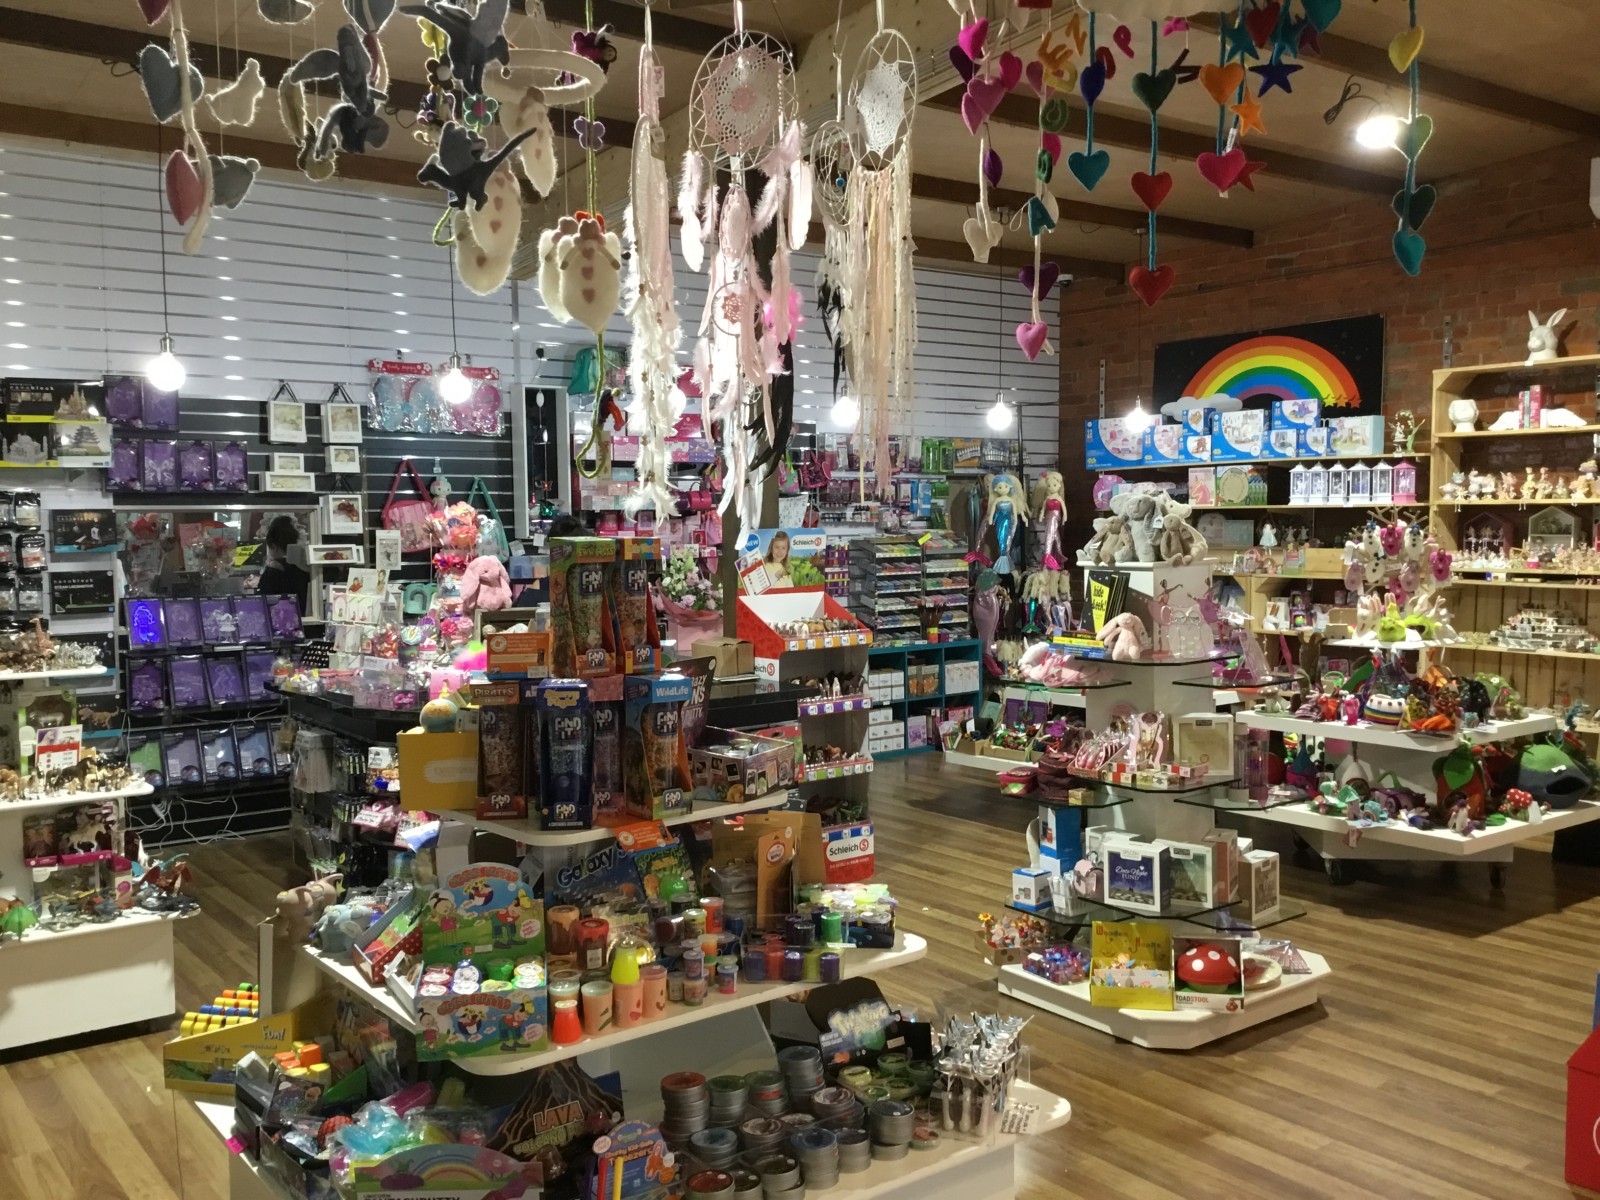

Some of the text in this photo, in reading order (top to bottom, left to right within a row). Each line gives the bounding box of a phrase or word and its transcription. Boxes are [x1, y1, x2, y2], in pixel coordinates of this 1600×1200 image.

[474, 687, 514, 698] PIRATES
[829, 843, 859, 857] Schleich
[557, 845, 614, 888] Galaxy
[533, 1100, 584, 1135] LAVA
